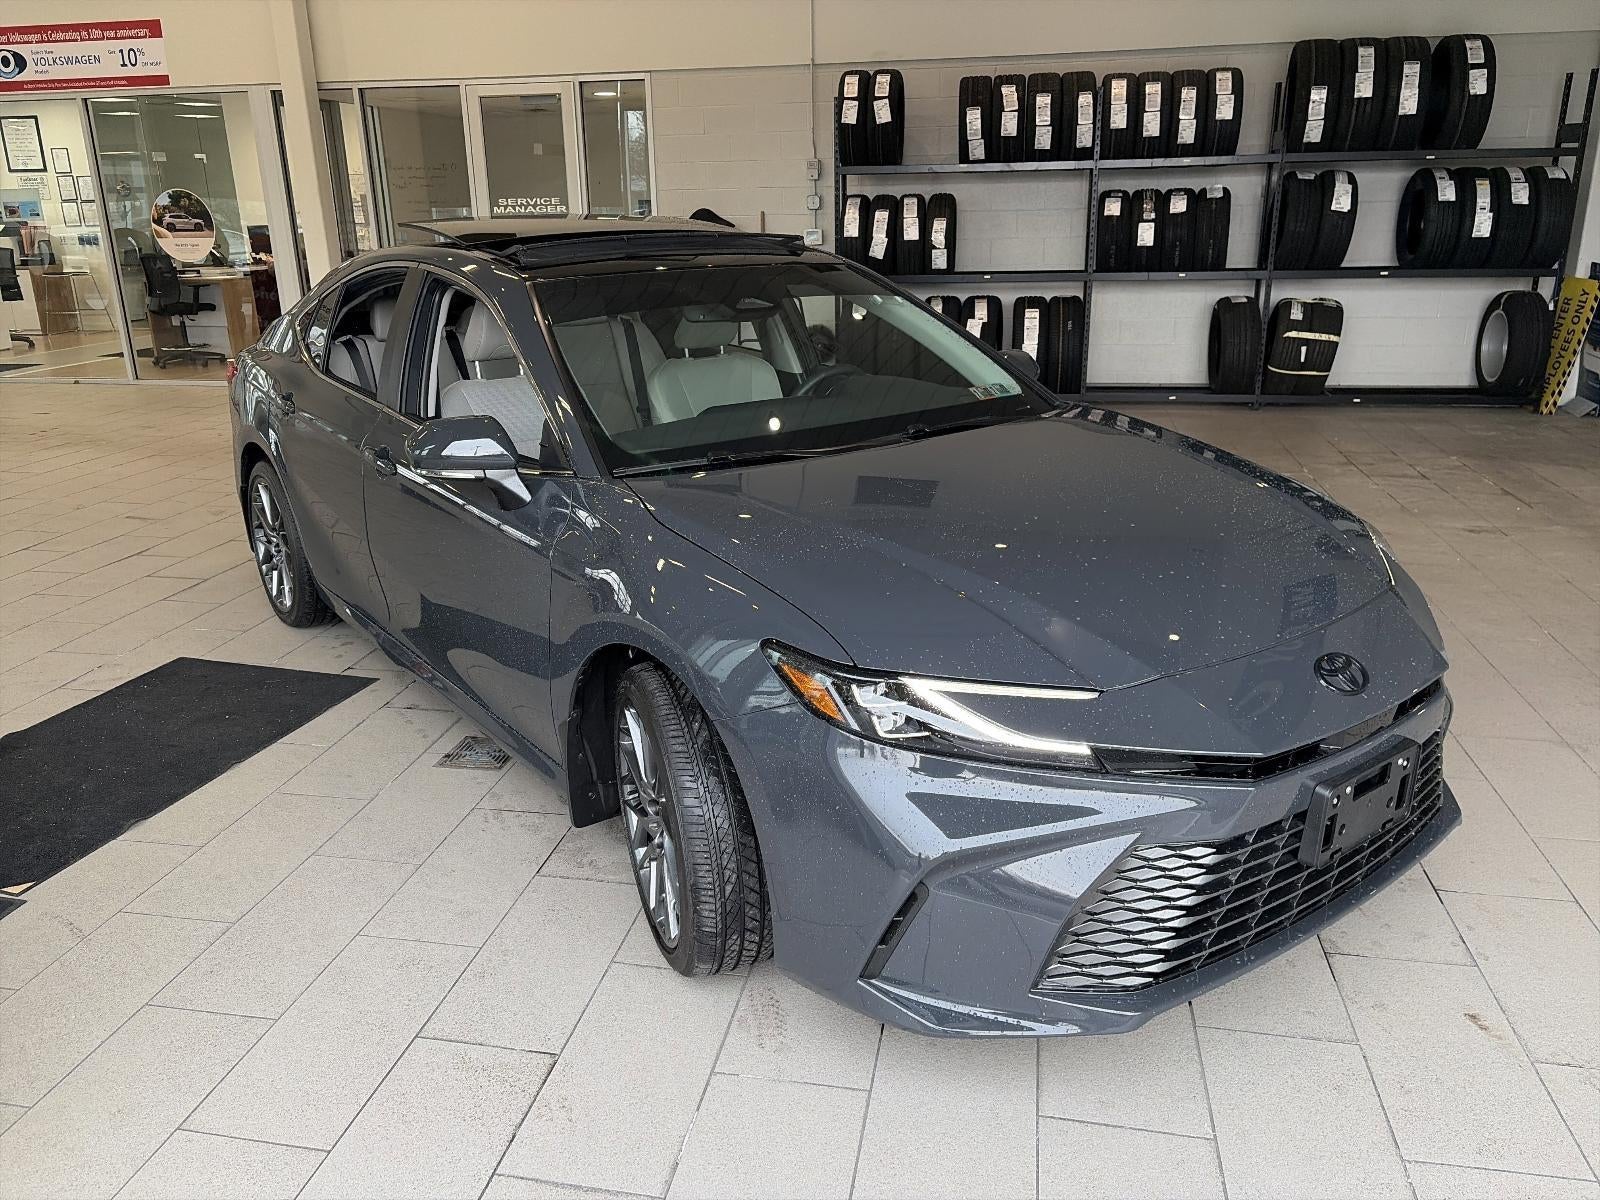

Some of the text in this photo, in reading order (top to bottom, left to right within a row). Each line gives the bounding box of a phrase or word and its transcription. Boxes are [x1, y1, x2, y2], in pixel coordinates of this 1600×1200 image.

[8, 31, 42, 44] Volkswagen
[42, 30, 48, 41] is
[48, 29, 81, 42] Celebrating
[81, 29, 89, 40] its
[89, 28, 103, 39] 10th
[103, 29, 116, 41] year
[32, 54, 101, 67] VOLKSWAGEN
[498, 197, 561, 206] SERVICE
[493, 205, 567, 214] MANAGER
[1552, 296, 1573, 340] ENTER
[1541, 288, 1590, 397] MPLOYEES ONLY
